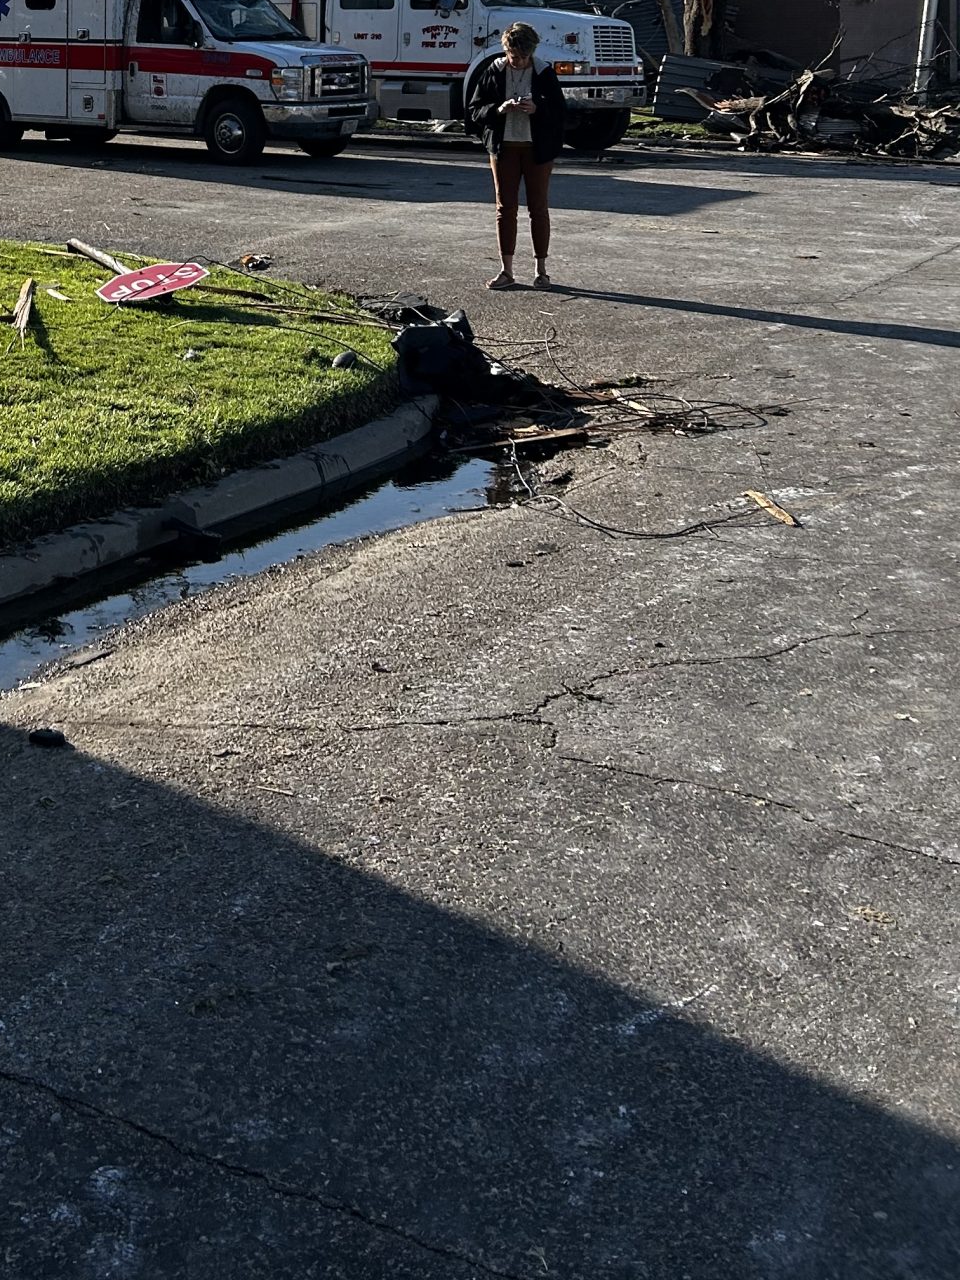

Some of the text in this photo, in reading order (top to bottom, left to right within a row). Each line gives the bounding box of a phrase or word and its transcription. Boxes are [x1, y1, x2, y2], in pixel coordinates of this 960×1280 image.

[422, 25, 459, 35] PERRYTON
[353, 32, 369, 40] UNIT
[421, 40, 458, 49] FIRE DEPT
[110, 266, 198, 299] STOP
